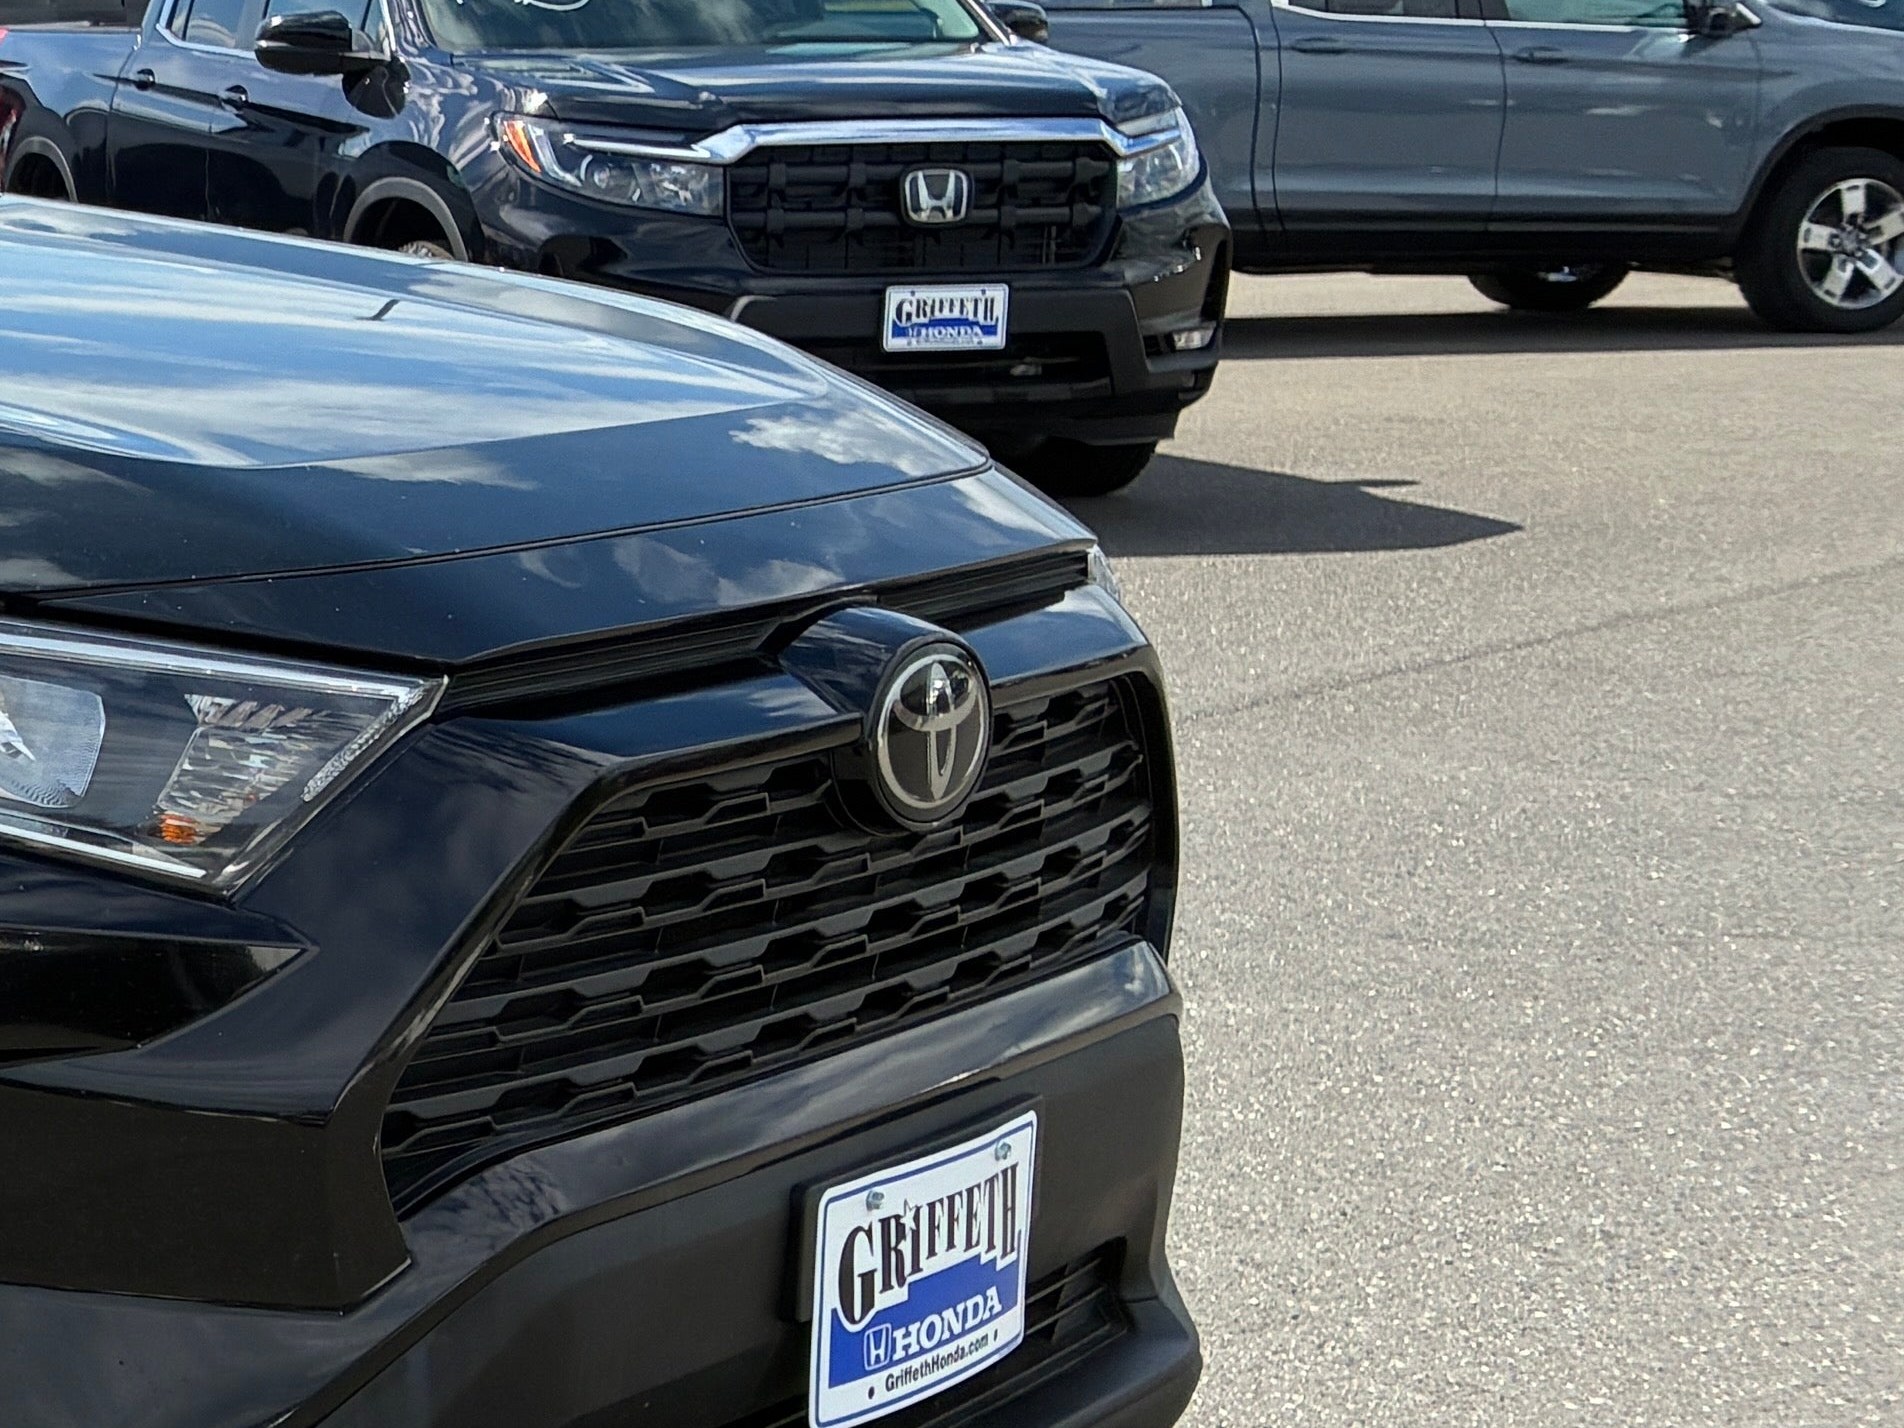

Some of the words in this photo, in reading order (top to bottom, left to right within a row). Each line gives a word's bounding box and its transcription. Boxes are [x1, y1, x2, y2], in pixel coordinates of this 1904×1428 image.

[895, 296, 999, 324] GRIFFETH
[921, 326, 983, 337] HONDA
[838, 1162, 1019, 1325] GRIFFETH
[893, 1286, 1002, 1361] HONDA
[885, 1334, 989, 1392] GriffethHonda.com
